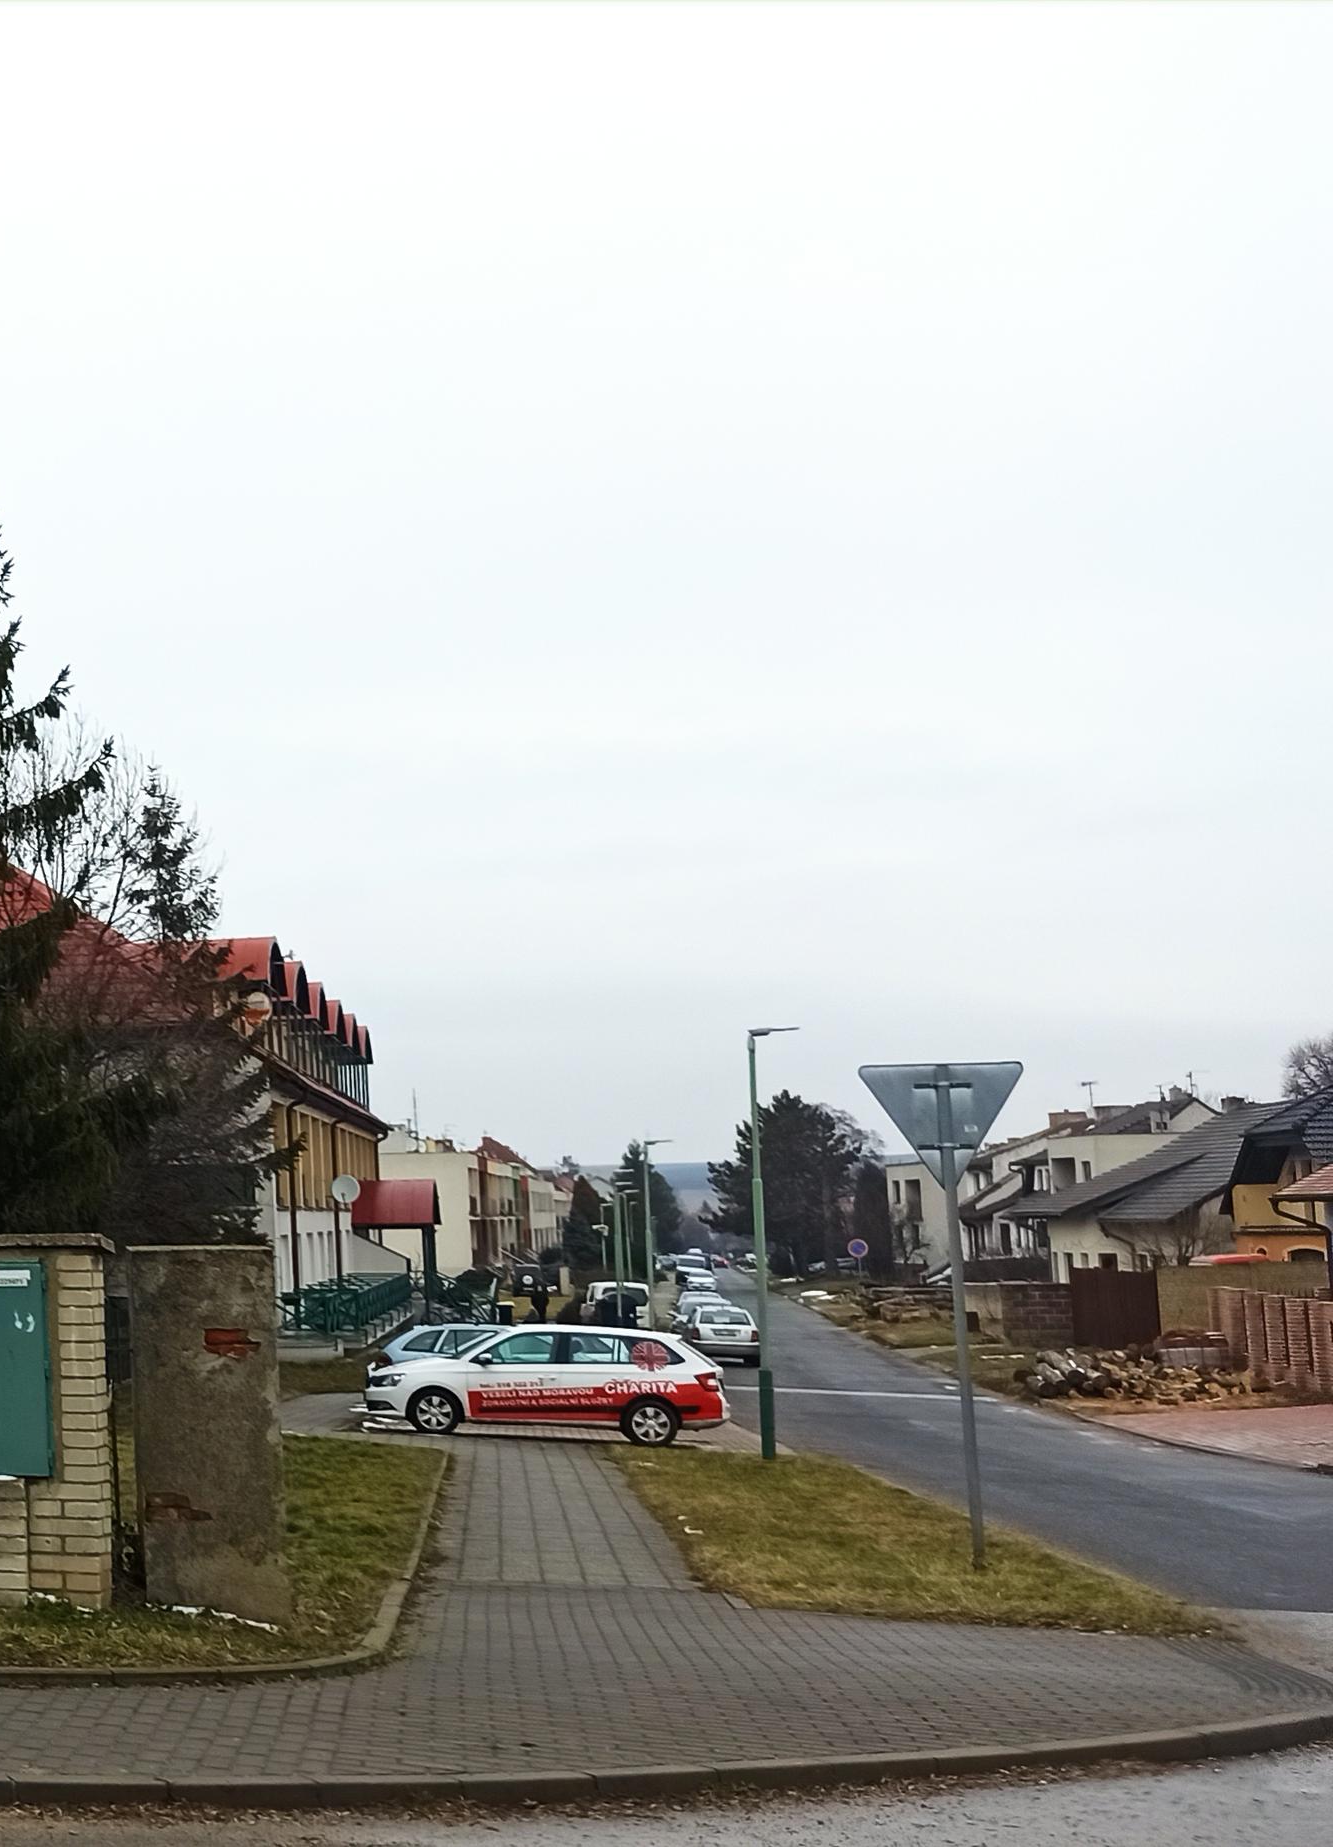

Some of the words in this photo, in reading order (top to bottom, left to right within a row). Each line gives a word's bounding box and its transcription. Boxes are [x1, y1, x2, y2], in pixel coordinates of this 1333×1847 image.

[518, 1389, 540, 1397] NAD
[542, 1388, 594, 1397] MORAVOU
[604, 1381, 678, 1394] CHARITA
